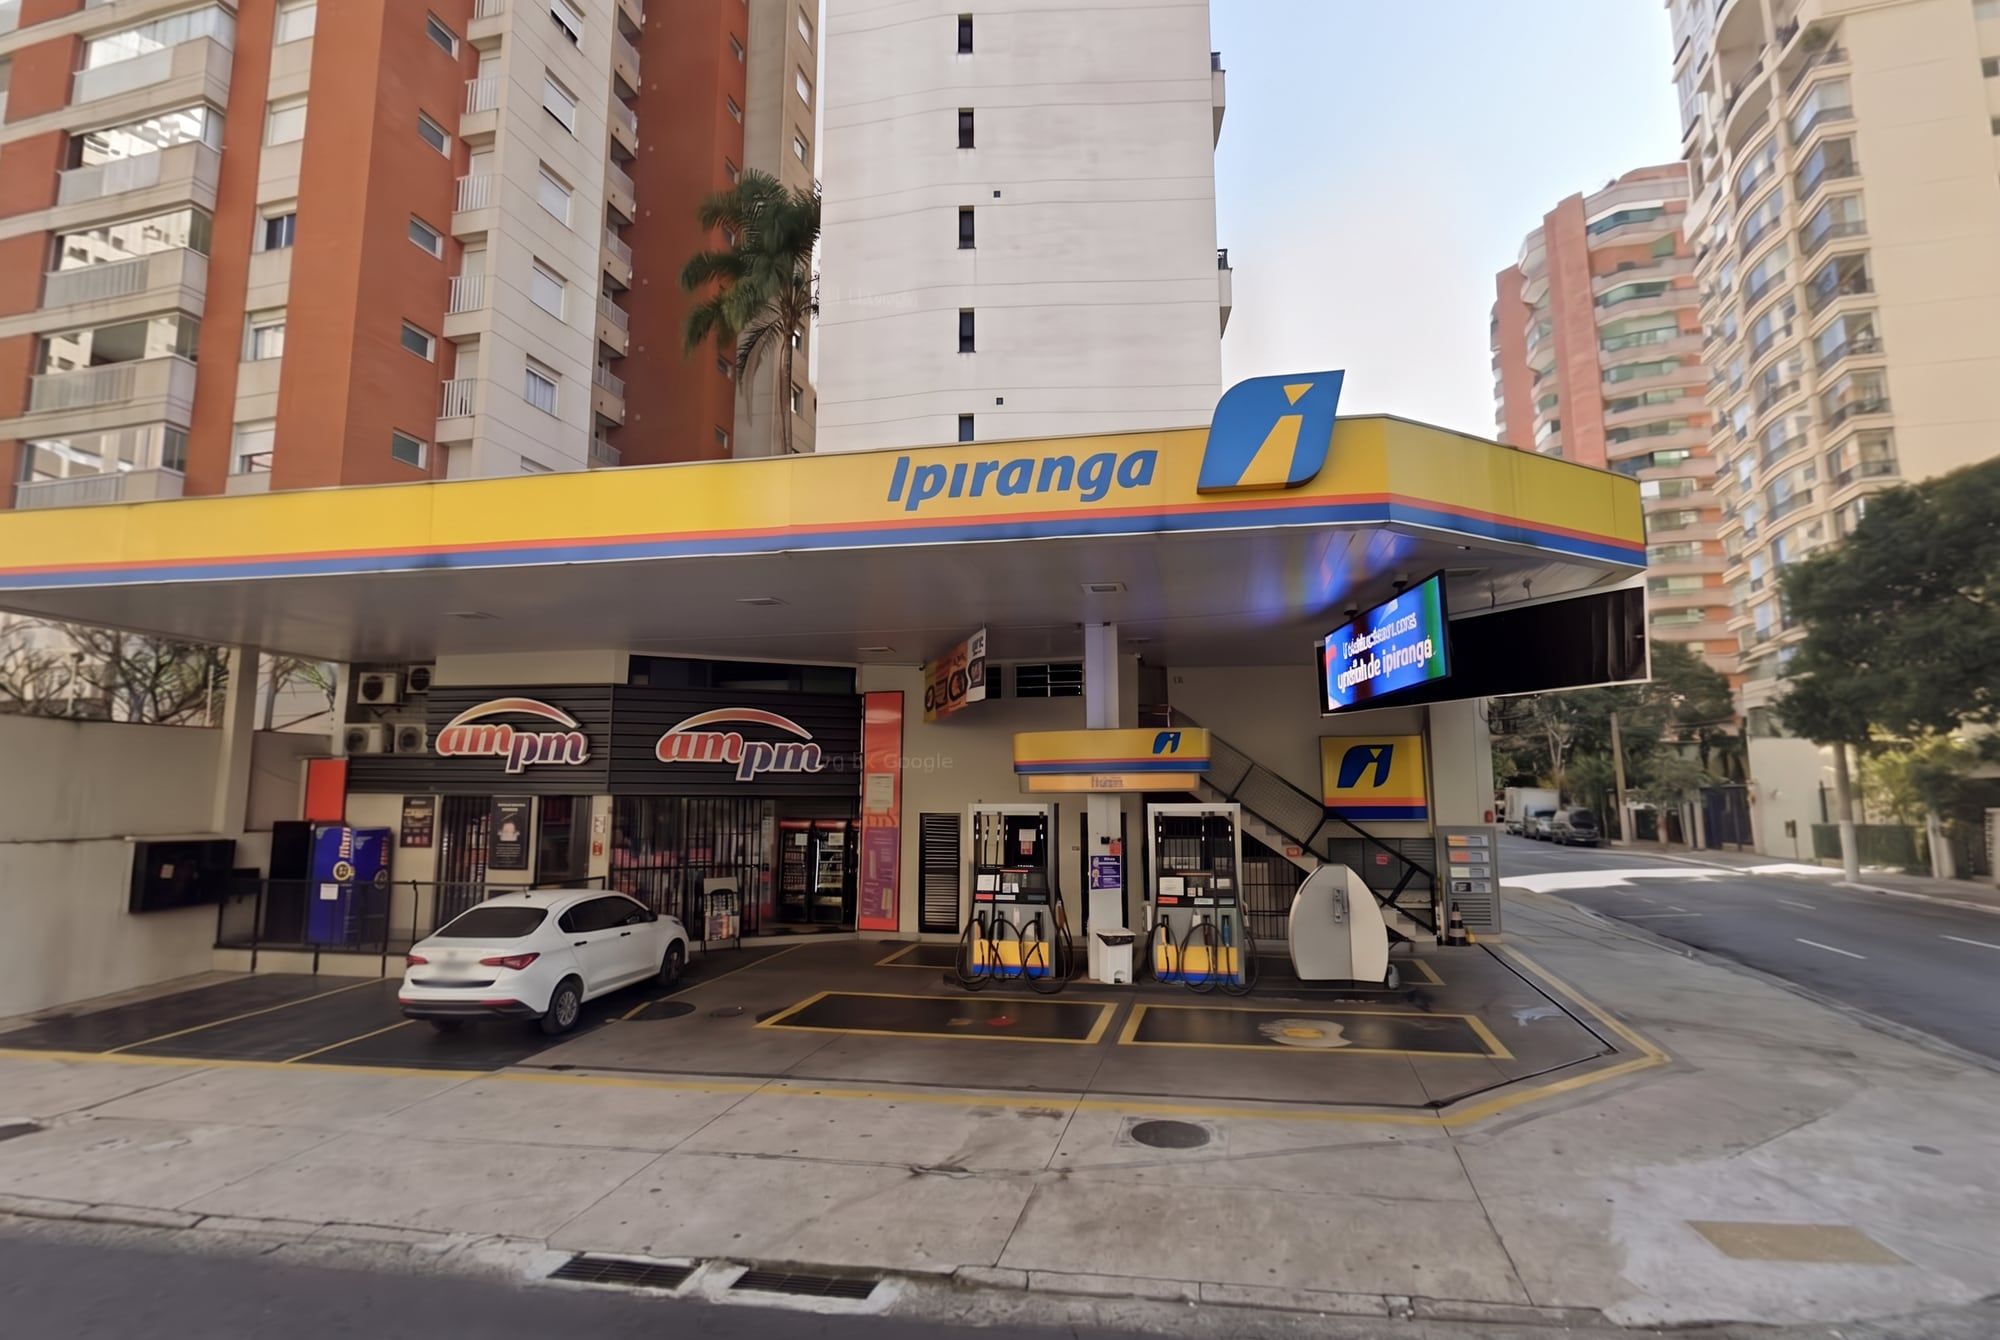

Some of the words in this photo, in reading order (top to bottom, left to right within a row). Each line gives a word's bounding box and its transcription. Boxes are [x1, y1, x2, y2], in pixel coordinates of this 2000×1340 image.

[887, 450, 1158, 511] Ipiranga
[436, 724, 590, 773] ampm
[656, 732, 823, 781] ampm
